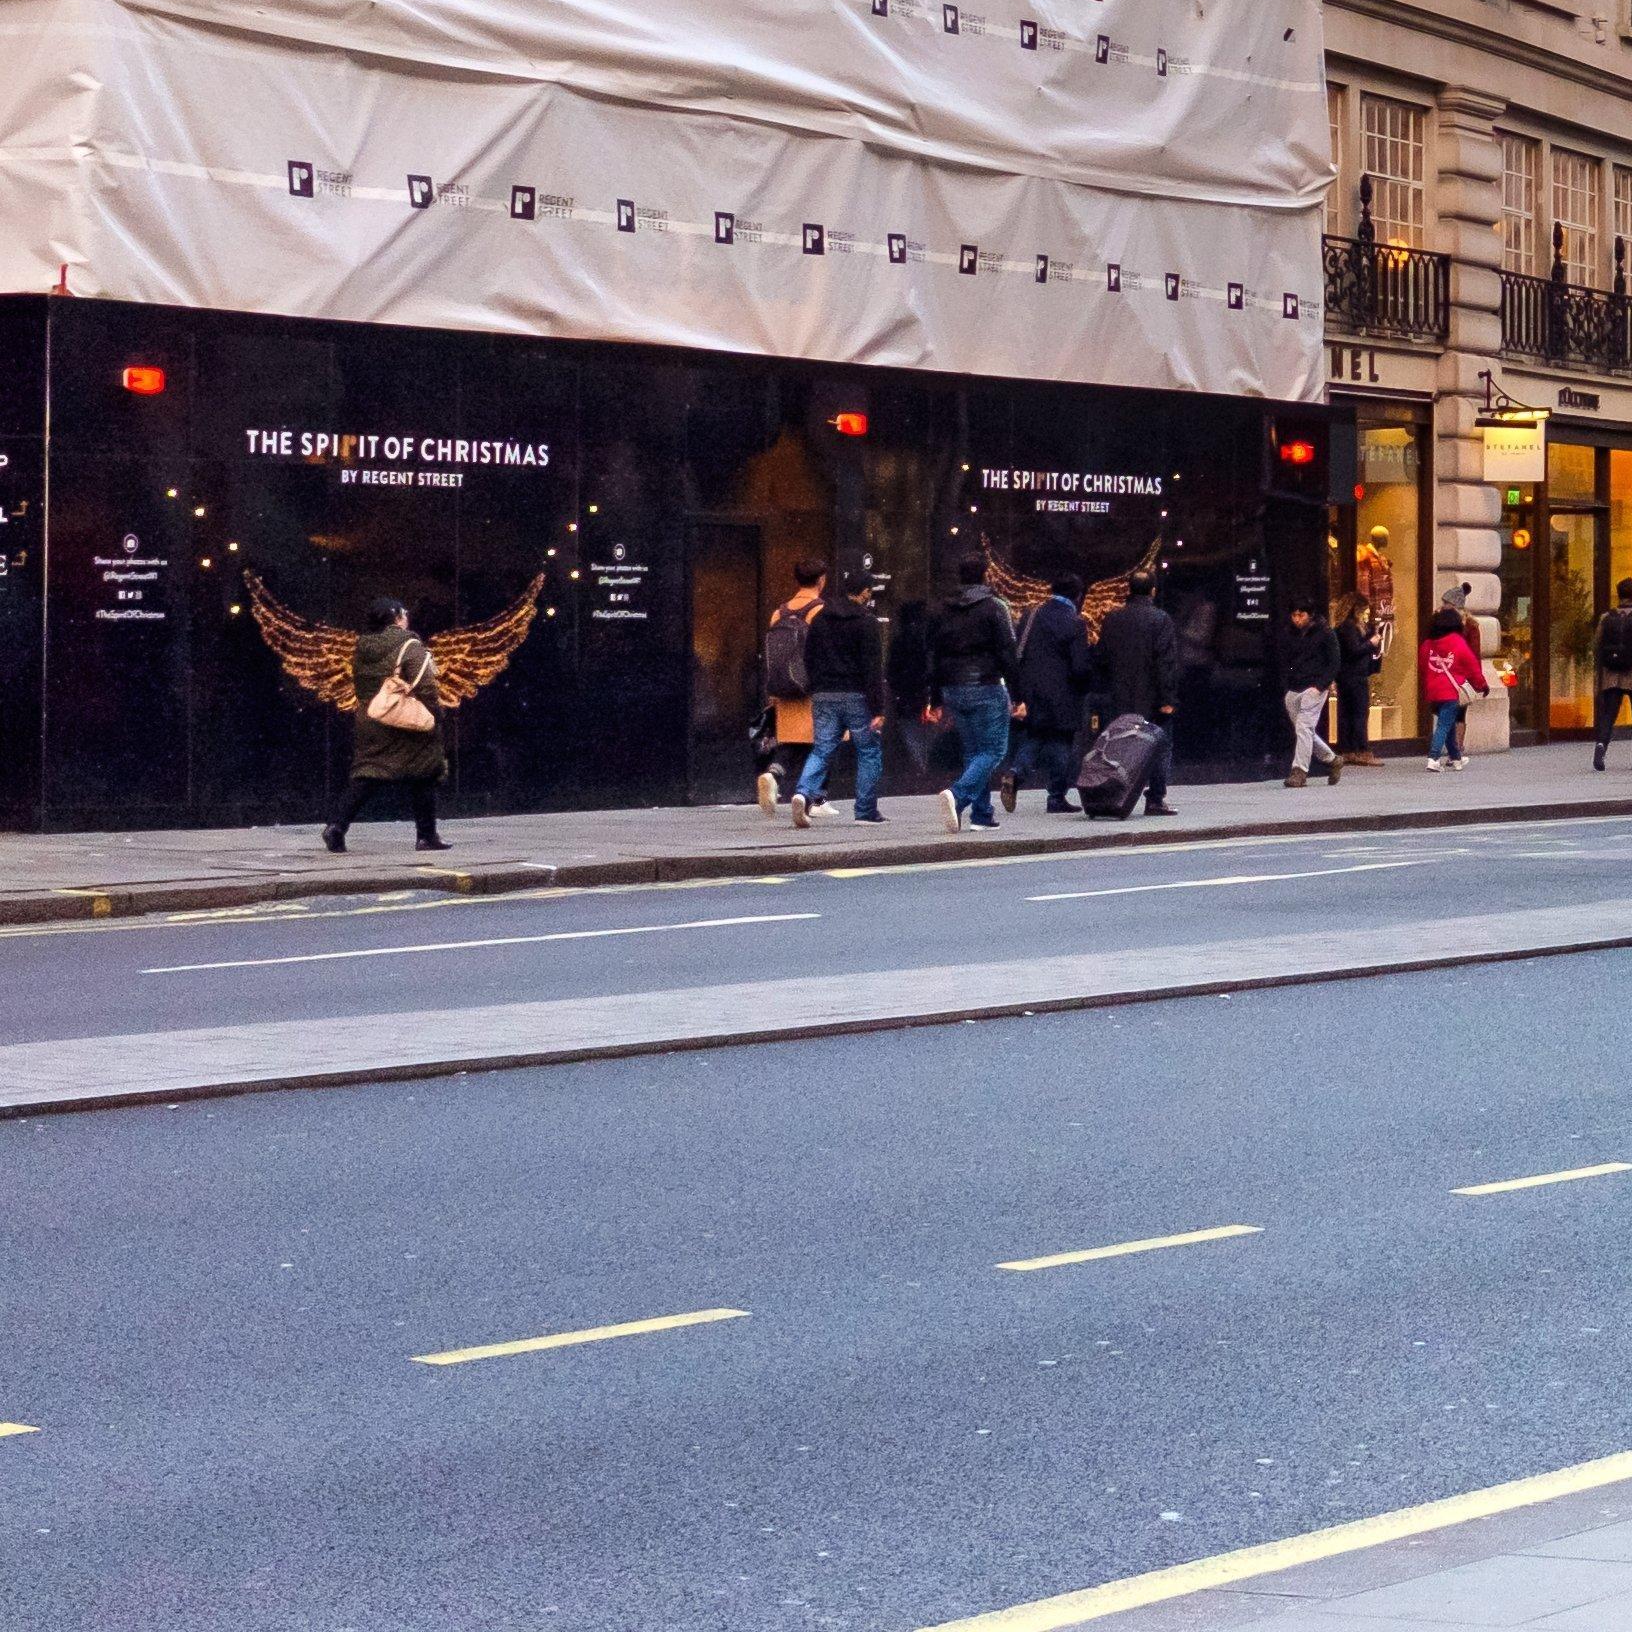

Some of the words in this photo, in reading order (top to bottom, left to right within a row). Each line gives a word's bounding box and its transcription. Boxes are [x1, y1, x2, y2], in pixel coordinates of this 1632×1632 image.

[317, 169, 354, 185] REGENT
[539, 194, 575, 207] REGENT
[246, 429, 293, 455] THE
[384, 436, 414, 460] OF
[420, 438, 549, 466] CHRISTMAS
[341, 469, 358, 484] BY
[362, 470, 414, 485] REGENT
[418, 472, 463, 487] STREET
[983, 469, 1008, 489] THE
[1062, 472, 1079, 492] OF
[1084, 474, 1162, 495] CHRISTMAS
[1036, 500, 1046, 511] BY
[1048, 500, 1079, 512] REGENT
[1082, 501, 1109, 513] STREET
